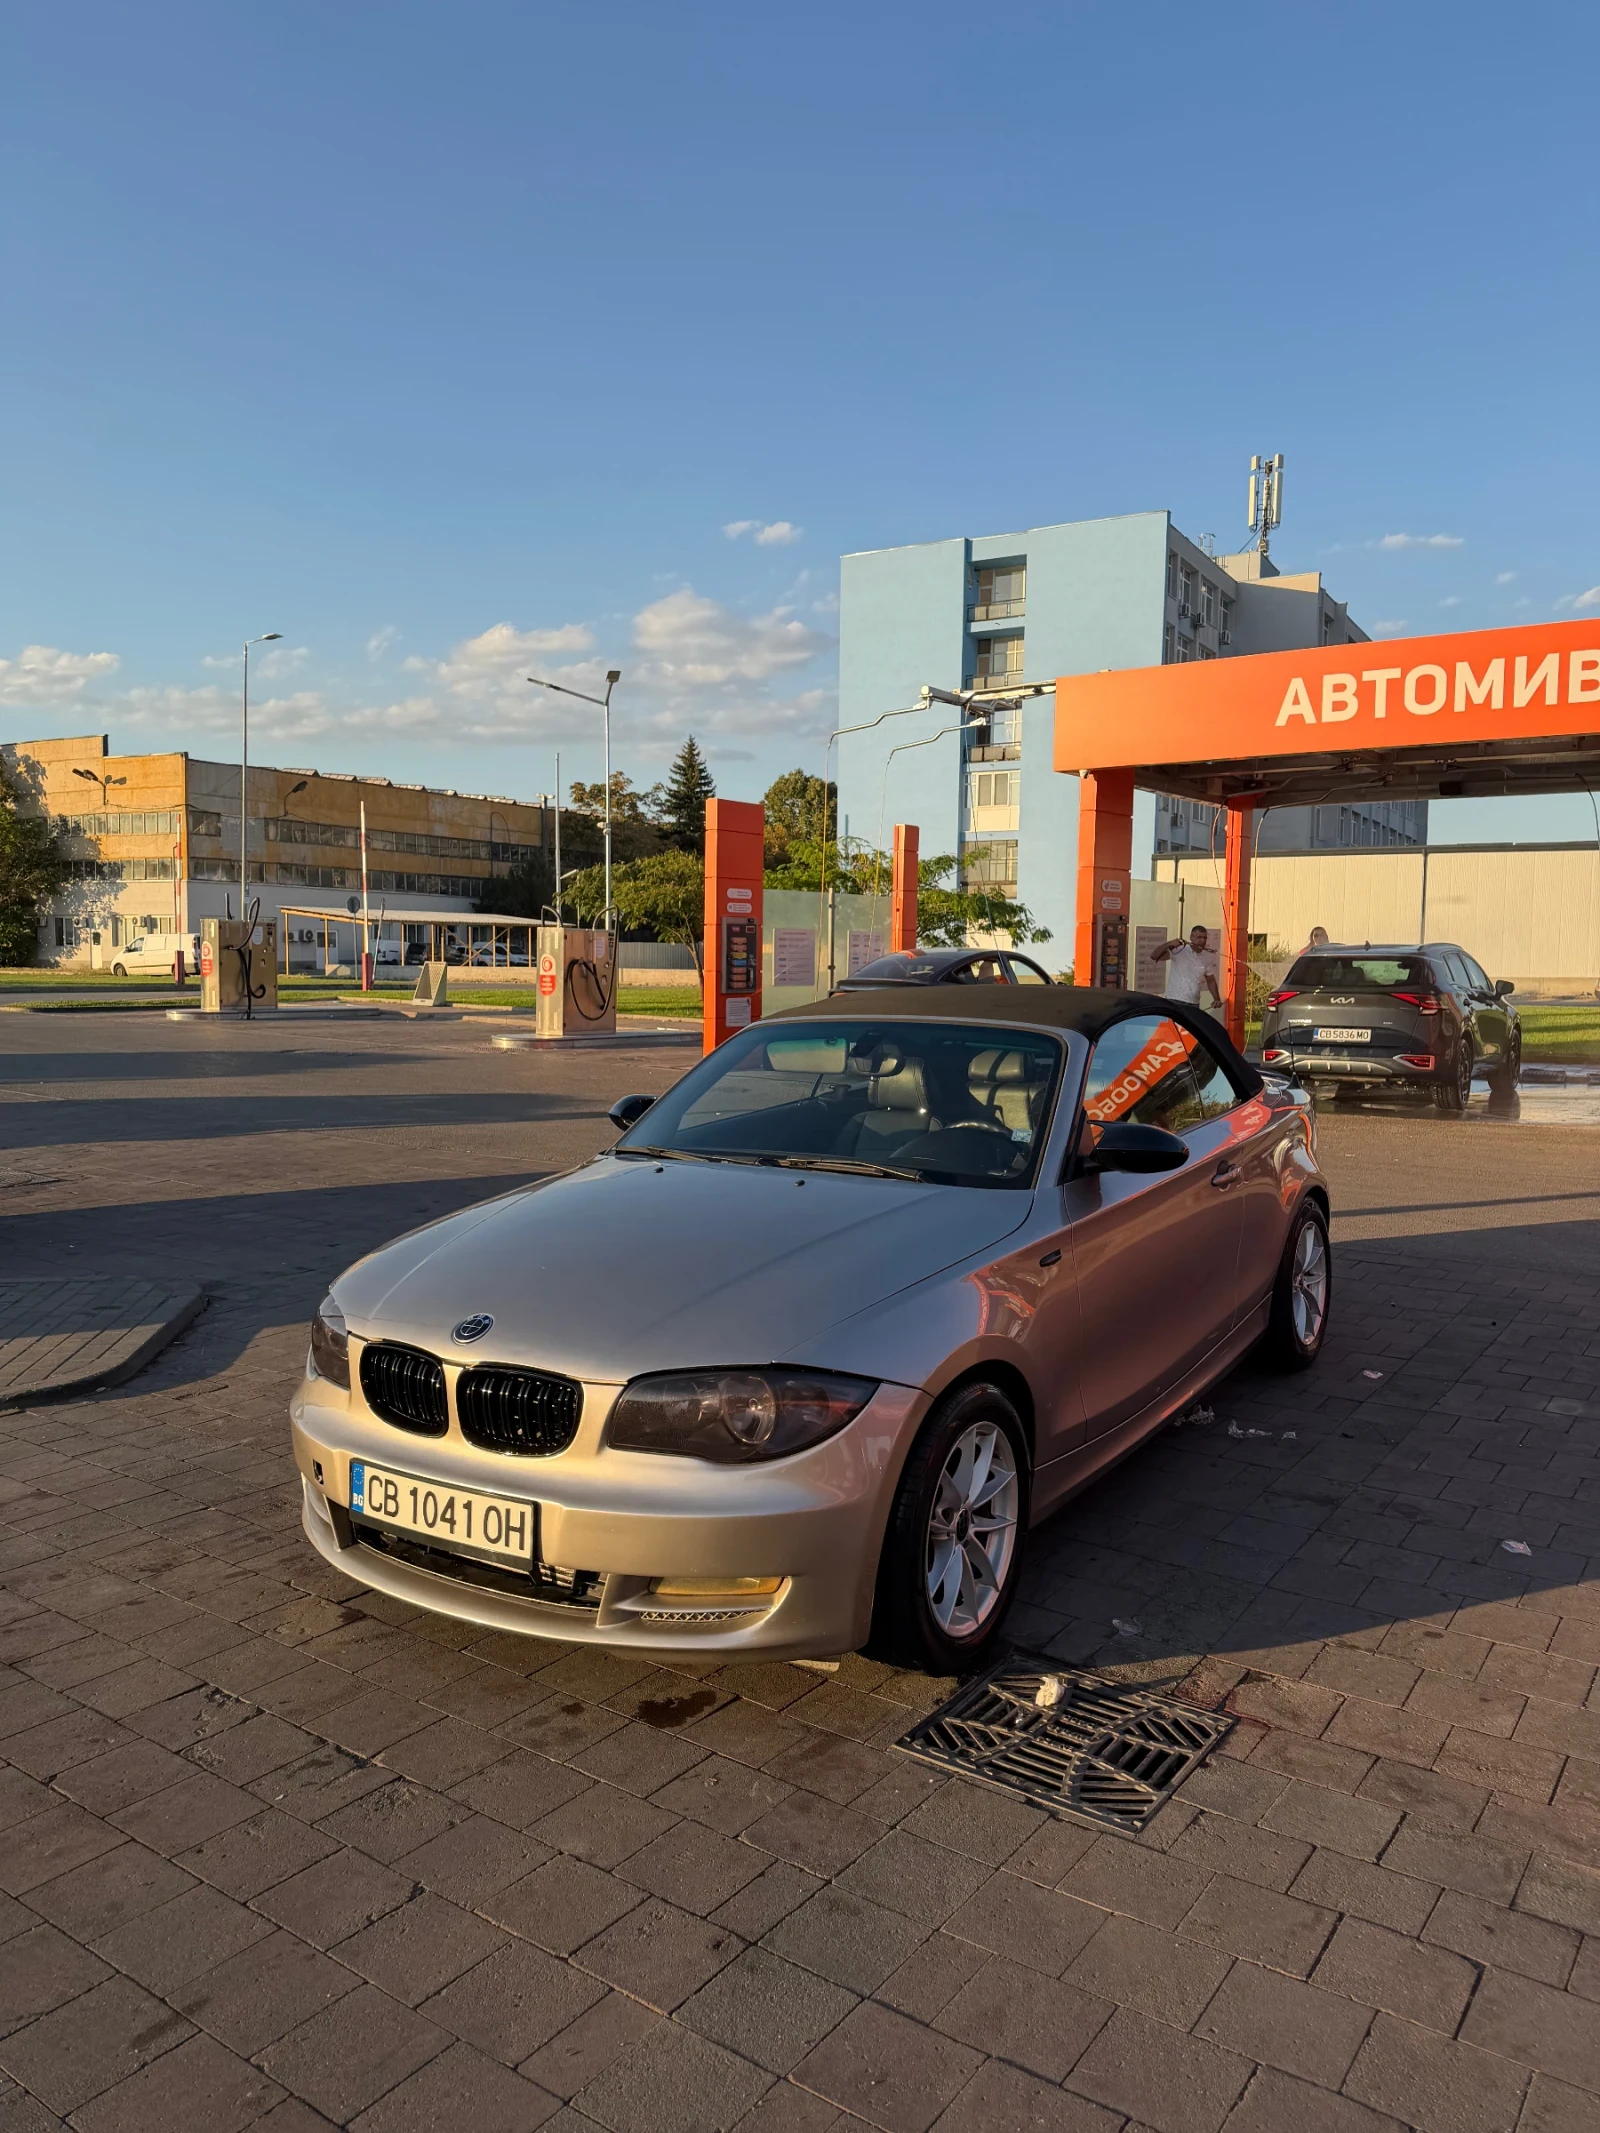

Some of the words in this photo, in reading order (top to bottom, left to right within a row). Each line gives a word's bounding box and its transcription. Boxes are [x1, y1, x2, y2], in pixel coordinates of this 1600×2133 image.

[1274, 649, 1600, 726] АВТОМИВ
[1319, 1030, 1332, 1038] CB
[1333, 1030, 1355, 1039] 5836
[353, 1492, 364, 1506] BG
[368, 1474, 399, 1518] CB
[409, 1486, 473, 1539] 1041
[483, 1505, 526, 1550] OH
